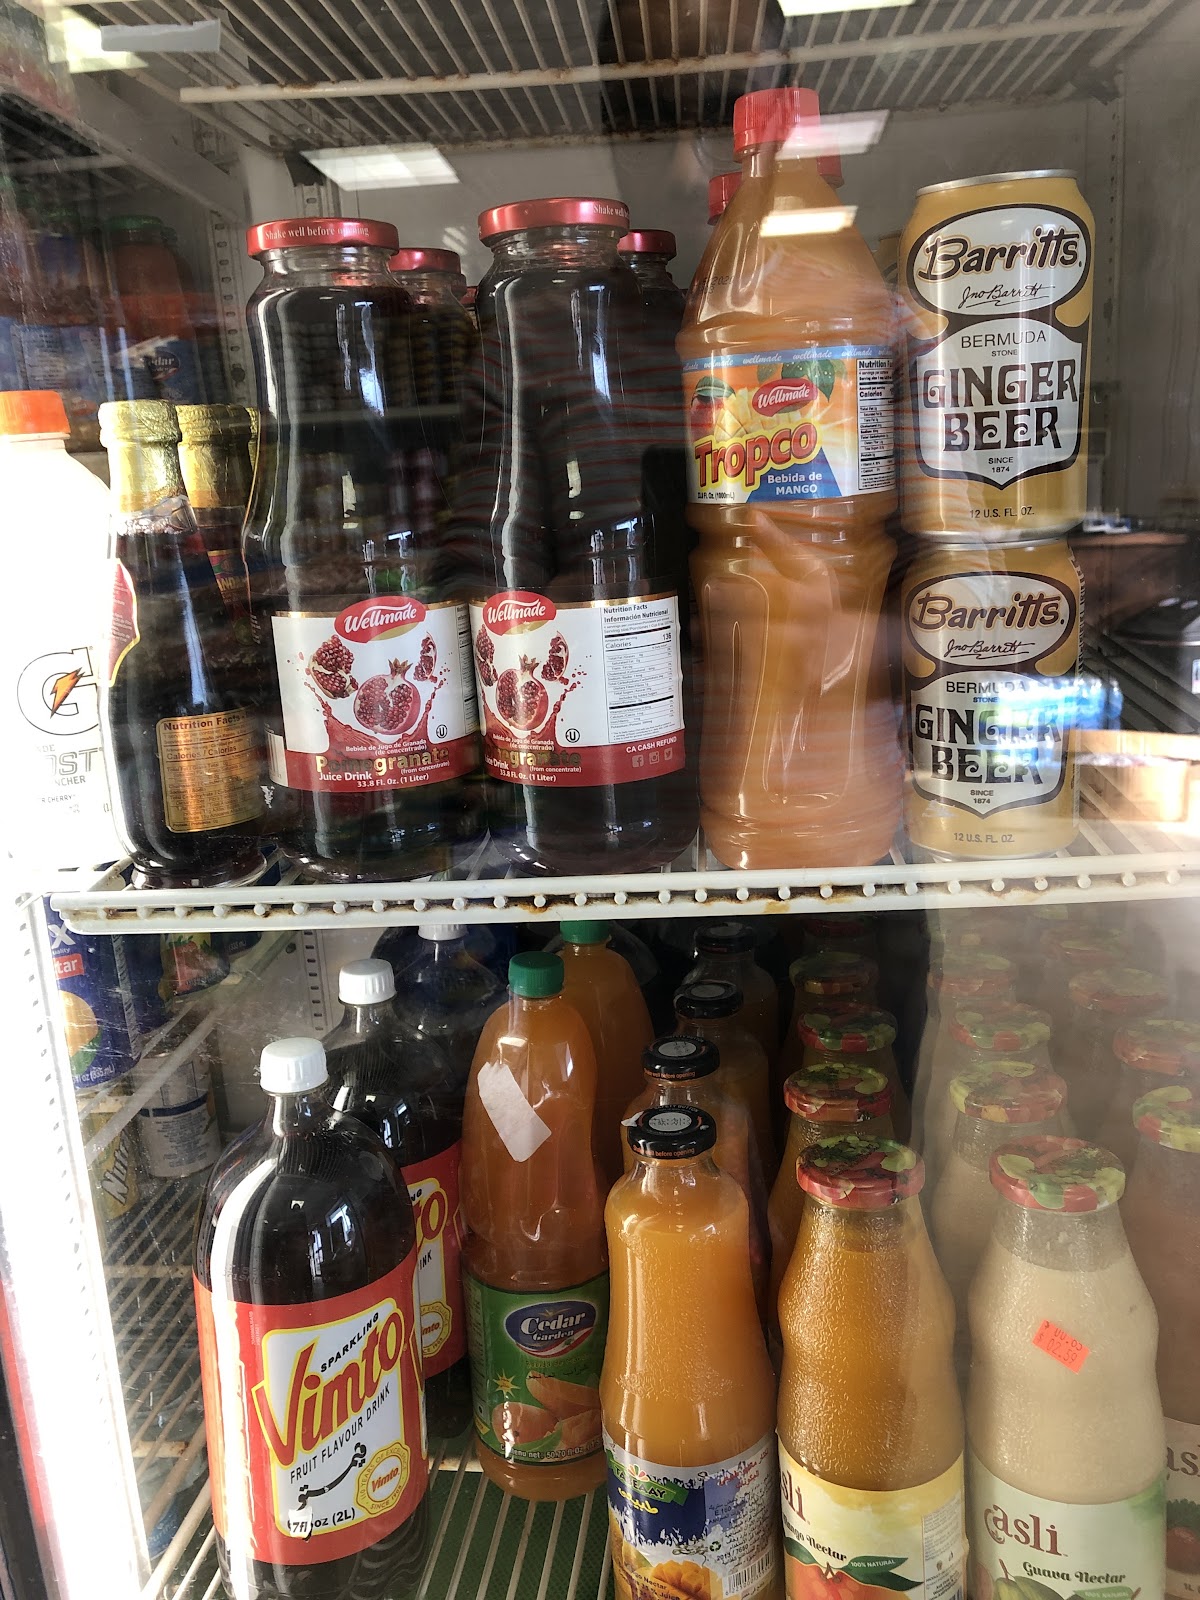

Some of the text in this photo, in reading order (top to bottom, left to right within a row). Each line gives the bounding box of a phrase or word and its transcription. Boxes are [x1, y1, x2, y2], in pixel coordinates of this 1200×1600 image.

[594, 204, 613, 215] Shake
[265, 230, 286, 240] Shake
[288, 227, 305, 237] well
[307, 226, 334, 236] before
[961, 330, 1047, 349] BERMUDA
[743, 354, 782, 365] wellmade
[793, 350, 832, 360] wellmade
[991, 349, 1018, 357] STONE
[859, 361, 887, 369] Nutrition
[923, 359, 1078, 409] GINGER
[757, 383, 811, 409] Wellmade
[943, 407, 1062, 451] BEER
[695, 422, 817, 487] Tropco
[988, 456, 1014, 465] SINCE
[767, 472, 822, 484] Bebida de
[775, 484, 818, 496] MANGO
[970, 509, 981, 518] 12
[983, 508, 1001, 518] U.S.
[344, 601, 417, 633] Wellmade
[487, 599, 546, 624] Wellmade
[603, 606, 632, 614] Nutrition
[642, 608, 668, 618] Nutricional
[164, 714, 240, 731] Nutrition Facts
[345, 744, 367, 752] Bebida
[368, 743, 376, 751] de
[377, 742, 392, 752] Jugo
[402, 738, 427, 747] Granada
[626, 736, 677, 754] CA CASH REFUND
[166, 746, 237, 760] Calories Calorias
[316, 747, 449, 776] Pomegranate
[400, 761, 450, 775] (from concentrate)
[493, 758, 509, 770] Drink
[931, 745, 1043, 785] BEER
[318, 771, 372, 781] Juice Drink
[499, 769, 511, 778] 33.8
[529, 773, 536, 782] (1
[537, 773, 556, 783] Liter)
[545, 765, 582, 774] concentrate)
[357, 773, 429, 788] 33.8 Fl. Oz. (1 Liter)
[970, 789, 994, 797] SINCE
[954, 833, 964, 842] 12
[966, 834, 982, 843] U.S.
[676, 1071, 695, 1079] opening
[673, 1147, 695, 1157] opening
[520, 1312, 586, 1335] Cedar
[320, 1312, 379, 1372] SPARKLING
[532, 1329, 574, 1341] Garden
[1046, 1338, 1077, 1364] 02.59
[255, 1312, 402, 1466] Vimto
[290, 1382, 391, 1484] FRUIT FLAVOUR DRINK
[371, 1467, 399, 1493] Vimto
[781, 1470, 807, 1522] sli
[371, 1500, 390, 1510] SINCE
[314, 1518, 329, 1528] oz
[332, 1507, 355, 1526] (2L)
[806, 1534, 847, 1561] Nectar
[867, 1559, 896, 1568] NATURAL
[1023, 1561, 1126, 1584] Guava Nectar
